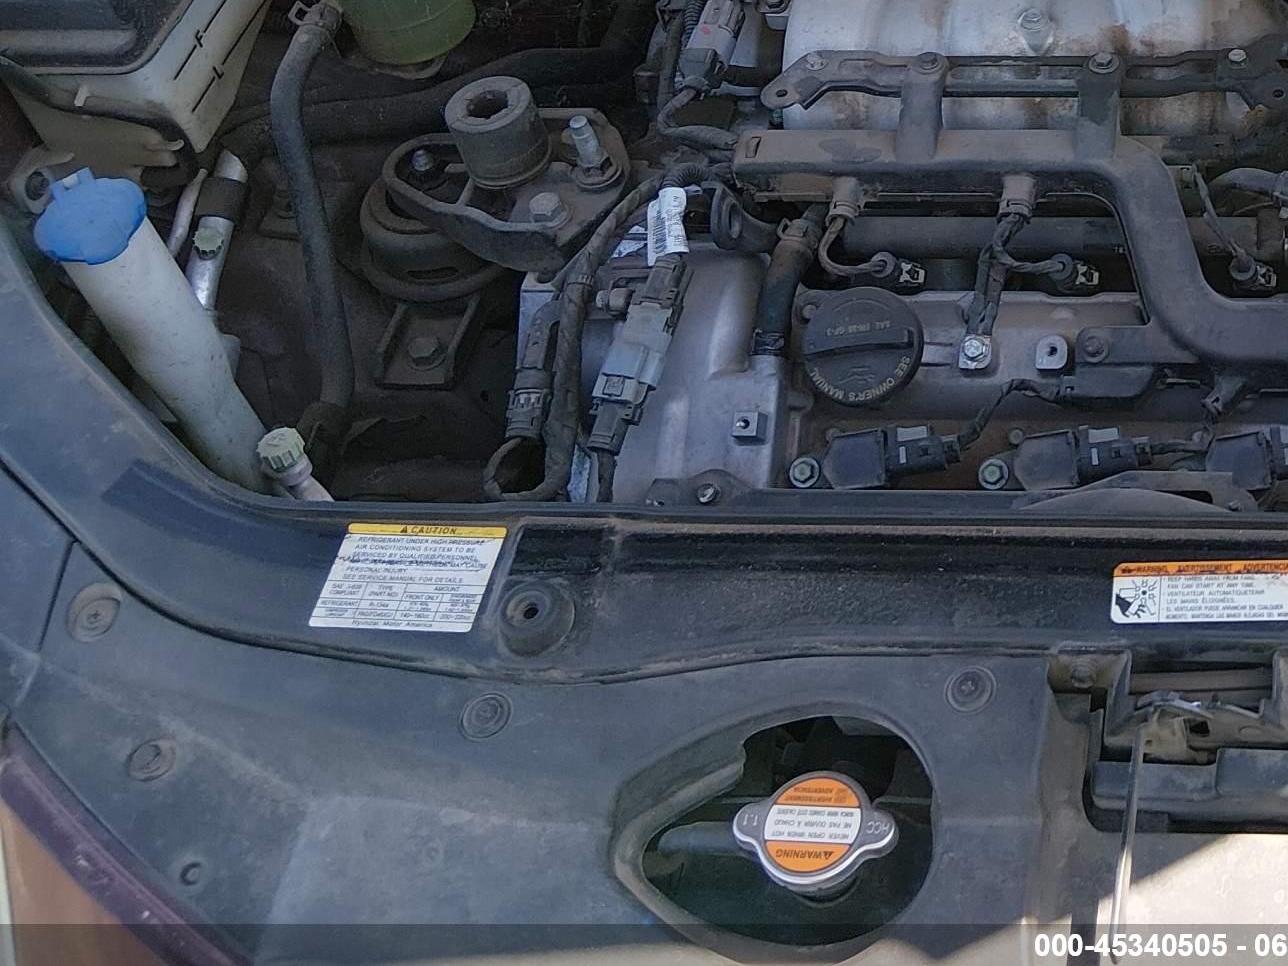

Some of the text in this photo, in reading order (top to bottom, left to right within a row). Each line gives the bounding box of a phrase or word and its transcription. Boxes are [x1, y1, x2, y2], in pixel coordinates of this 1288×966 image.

[195, 30, 203, 47] F
[213, 66, 224, 80] L
[810, 356, 911, 401] SEE OWNER'S MANUAL
[412, 527, 457, 535] CAUTION
[352, 619, 379, 627] Hyundai
[866, 822, 890, 834] HCC
[776, 849, 824, 859] WARNING
